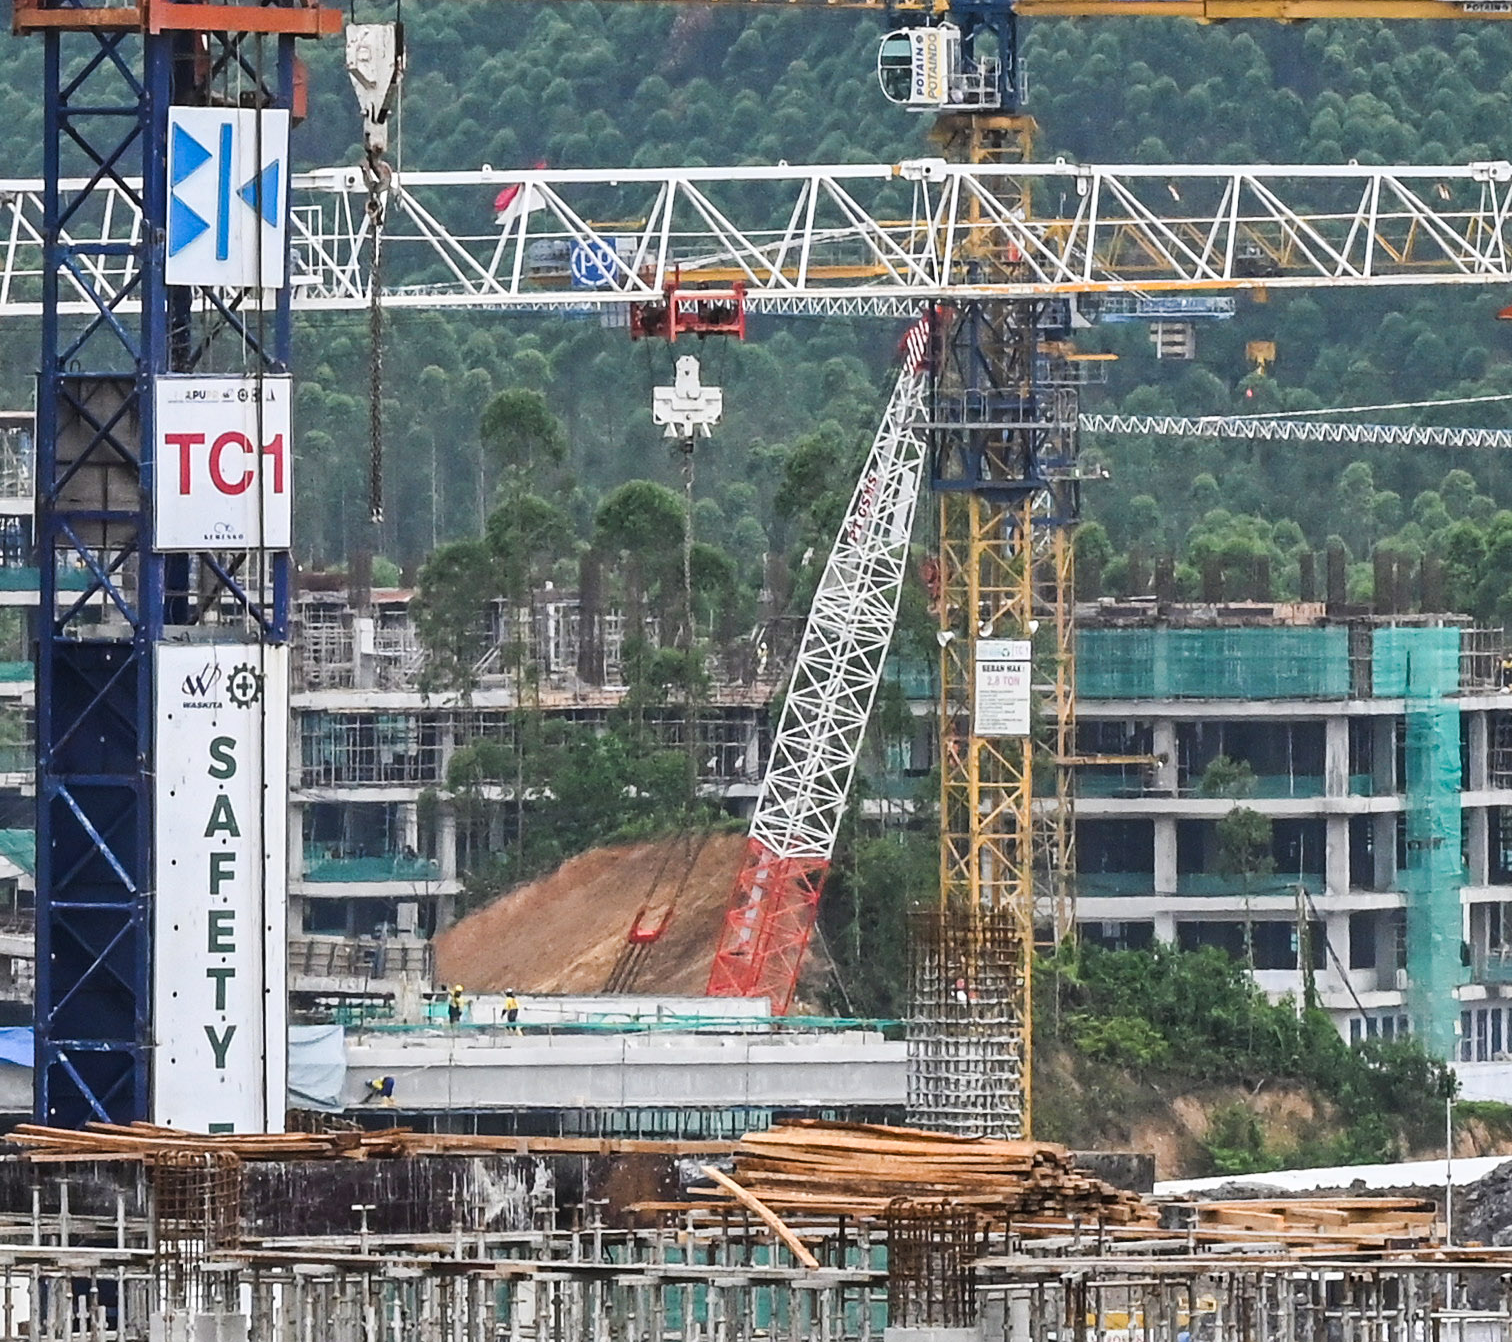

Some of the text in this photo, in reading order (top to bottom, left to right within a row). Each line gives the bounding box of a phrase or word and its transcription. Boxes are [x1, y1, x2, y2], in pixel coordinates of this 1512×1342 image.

[916, 47, 925, 96] POTAIN
[165, 431, 283, 496] TC1
[204, 736, 241, 1069] SAFETY
